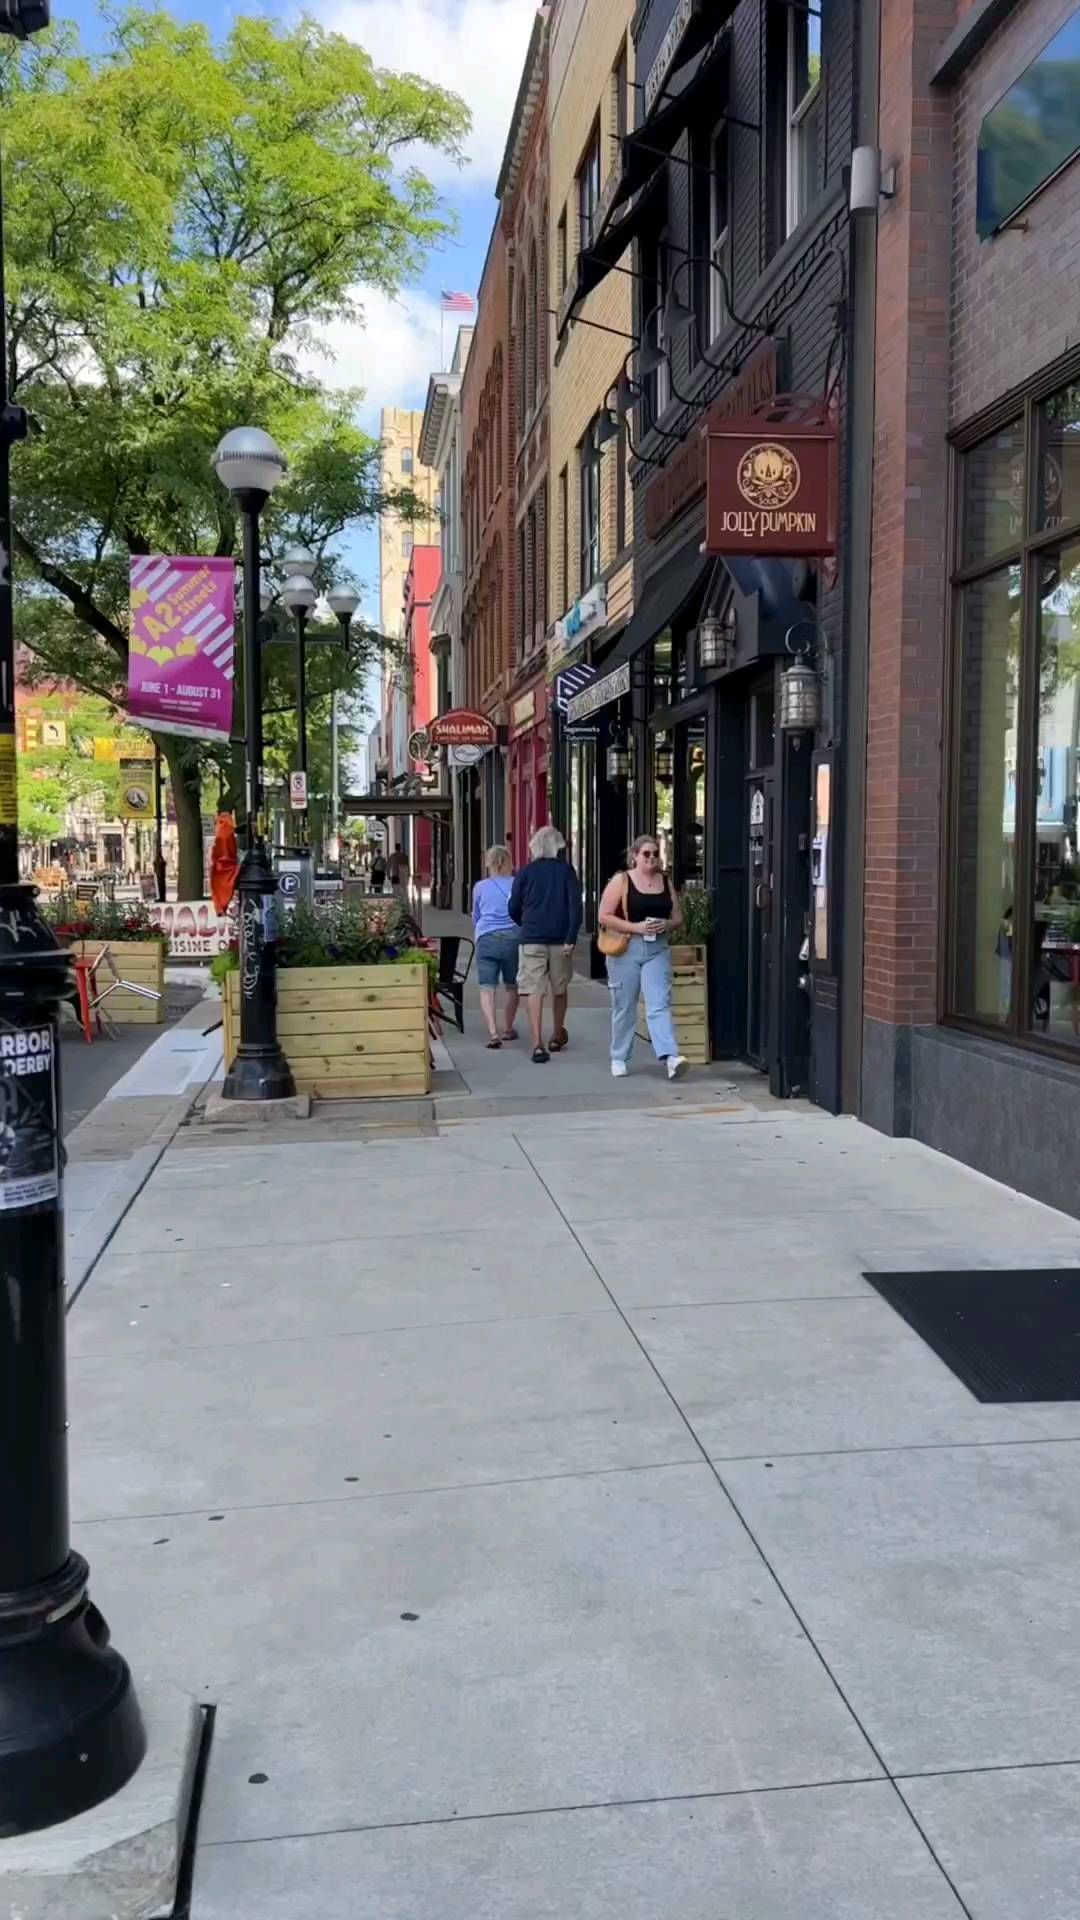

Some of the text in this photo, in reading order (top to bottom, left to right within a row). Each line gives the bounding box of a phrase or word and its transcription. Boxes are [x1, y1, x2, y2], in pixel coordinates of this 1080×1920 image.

[721, 511, 817, 537] JOLLY PUMPKIN
[167, 564, 212, 605] Summer
[177, 580, 218, 617] Streets
[142, 601, 182, 642] A2
[140, 681, 162, 694] JUNE
[164, 684, 169, 695] 1
[176, 684, 209, 698] AUGUST
[209, 687, 221, 700] 31
[435, 723, 489, 735] SHALIMAR
[285, 877, 296, 890] P
[0, 1030, 50, 1058] RBOR
[3, 1053, 51, 1077] DERBY
